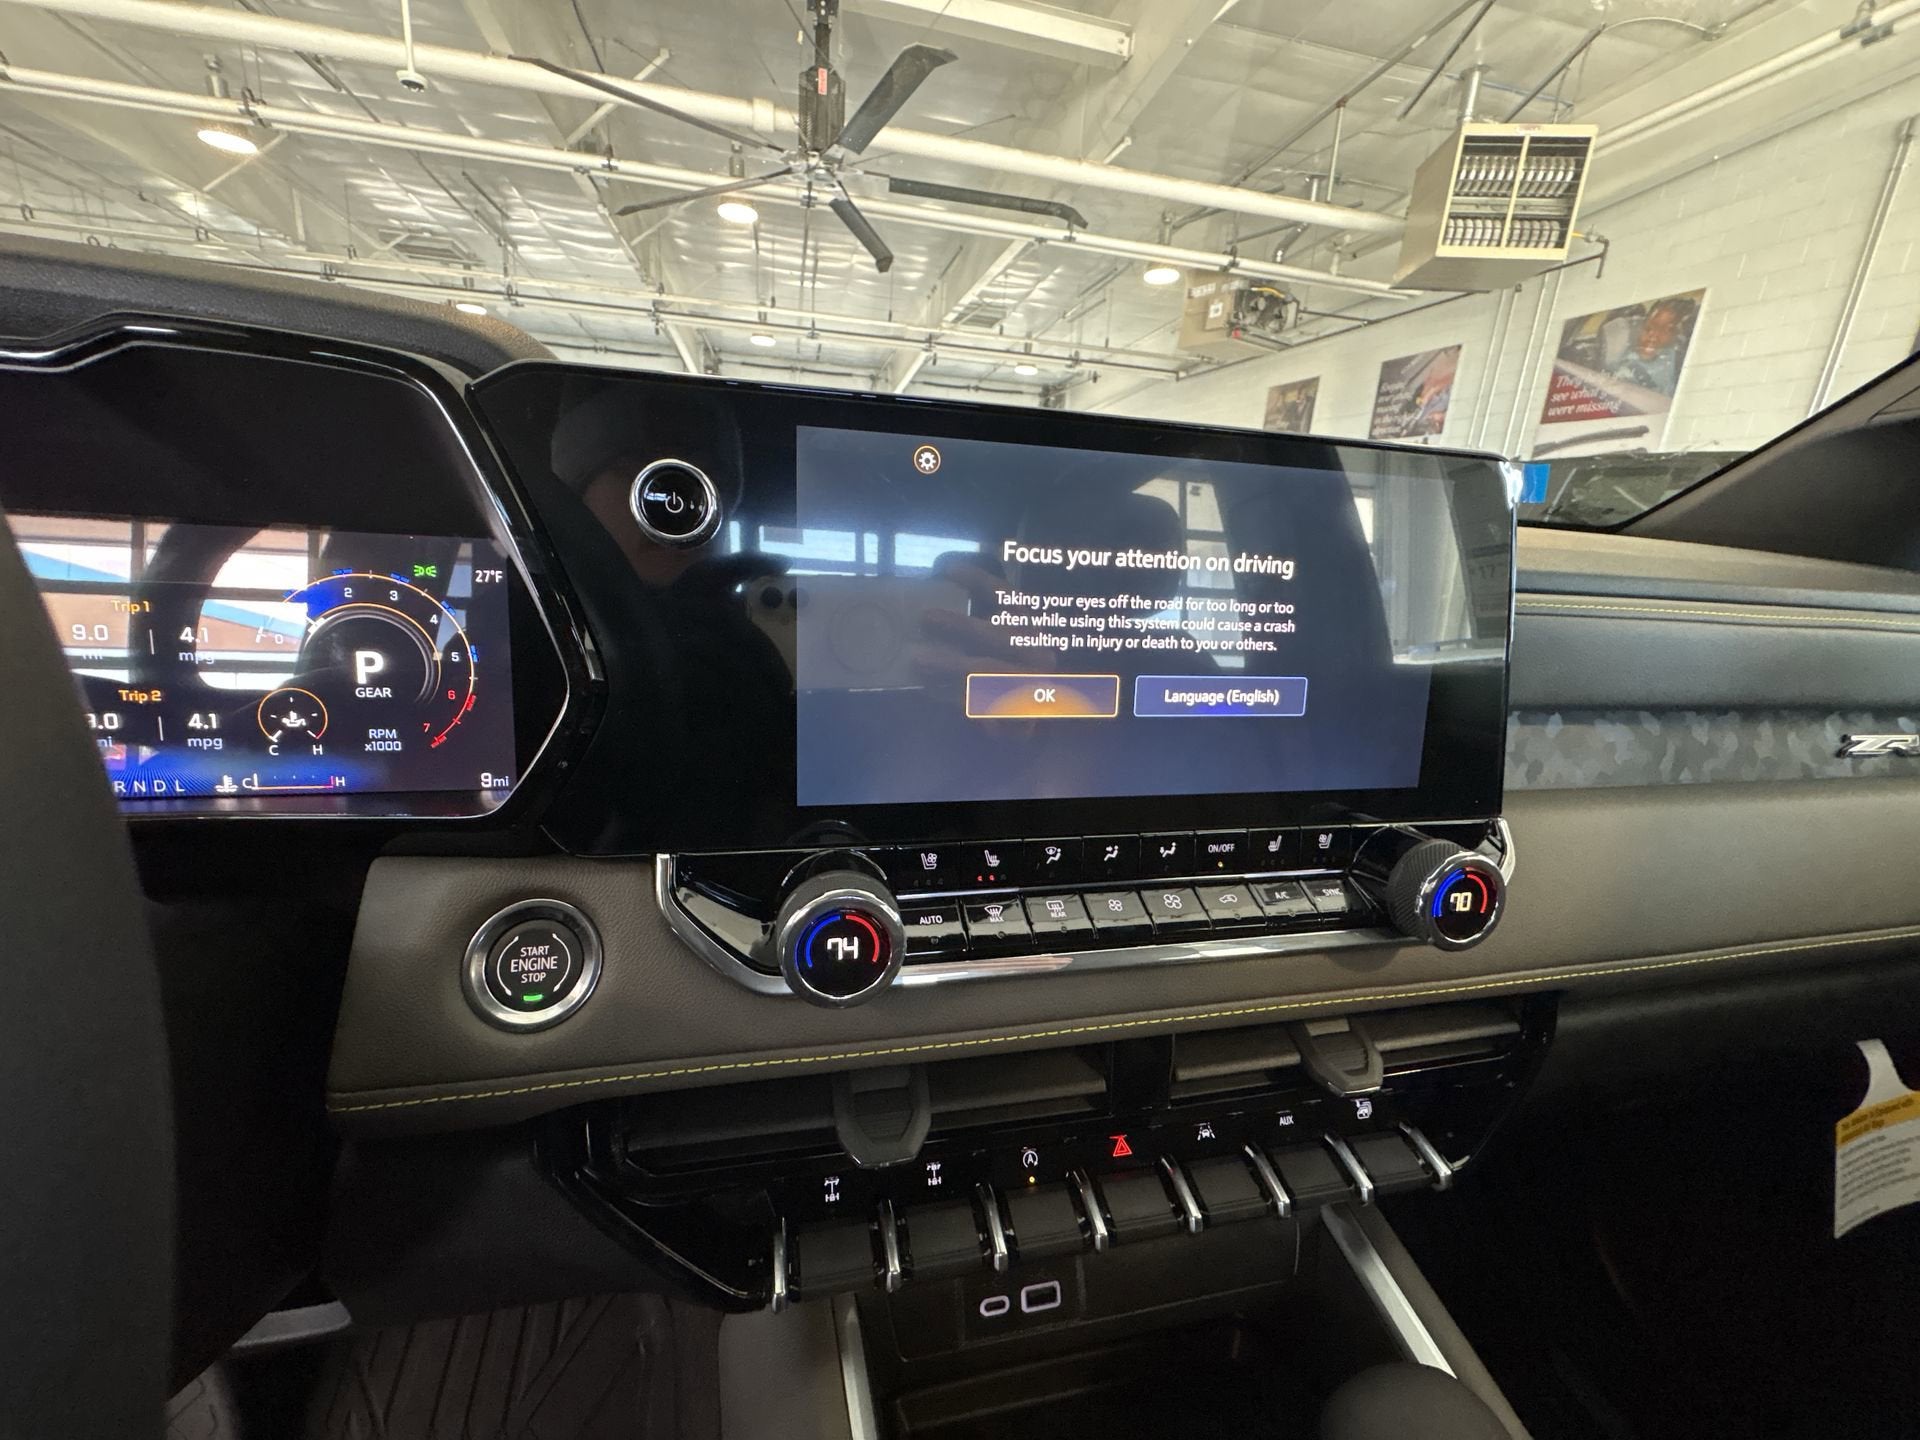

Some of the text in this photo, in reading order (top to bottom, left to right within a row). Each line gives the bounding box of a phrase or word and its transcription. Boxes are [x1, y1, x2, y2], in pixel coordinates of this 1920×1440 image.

[1003, 540, 1294, 580] Focus your attention on driving
[475, 569, 503, 583] 27°F
[344, 587, 353, 598] 2
[389, 590, 399, 601] 3
[111, 600, 150, 614] Trip 1
[995, 590, 1294, 616] Taking your eyes off the road for too long or too
[429, 614, 438, 625] 4
[991, 611, 1295, 633] often while using this system could cause a crash
[72, 624, 109, 641] 9.0
[180, 626, 209, 643] 4.1
[1010, 632, 1278, 653] resulting in injury or death to you or others.
[451, 651, 460, 662] 5
[355, 650, 385, 684] P
[118, 689, 162, 704] Trip 2
[355, 687, 392, 698] GEAR
[448, 690, 456, 700] 6
[1033, 688, 1056, 703] OK
[1164, 689, 1280, 707] Language (English)
[188, 712, 218, 729] 4.1
[368, 729, 397, 739] RPM
[423, 722, 431, 733] 7
[187, 737, 223, 750] mpg
[312, 744, 323, 756] H
[364, 741, 402, 751] x1000
[269, 745, 279, 756] C
[114, 779, 186, 792] R N D L
[335, 776, 345, 787] H
[1207, 843, 1236, 853] ON/OFF
[1274, 891, 1290, 900] A/C
[1449, 891, 1473, 912] 70
[919, 914, 943, 925] AUTO
[989, 915, 1005, 923] MAX
[520, 945, 550, 958] START
[826, 936, 859, 960] 74
[510, 955, 558, 973] ENGINE
[521, 971, 547, 984] STOP
[1279, 1114, 1295, 1126] AUX
